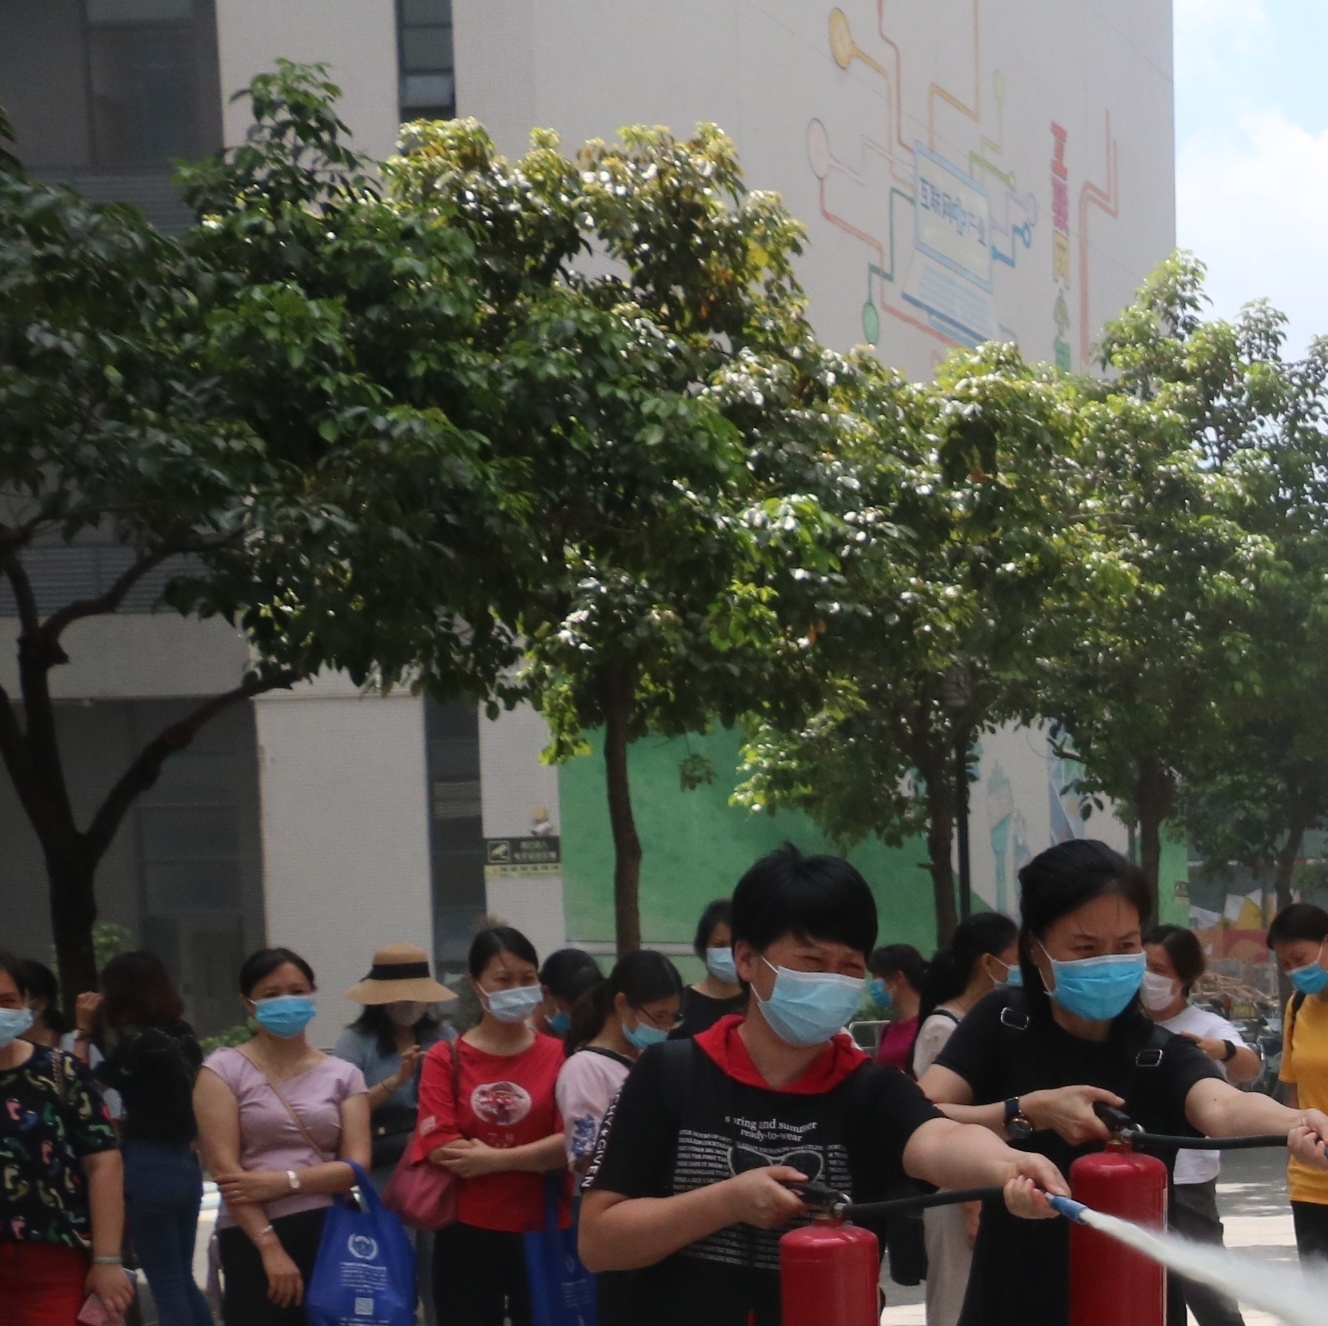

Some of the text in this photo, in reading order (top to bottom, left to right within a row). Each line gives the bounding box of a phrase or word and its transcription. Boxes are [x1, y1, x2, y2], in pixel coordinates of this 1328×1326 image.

[724, 1115, 818, 1133] sring and summer
[740, 1128, 803, 1142] ready-to-wear
